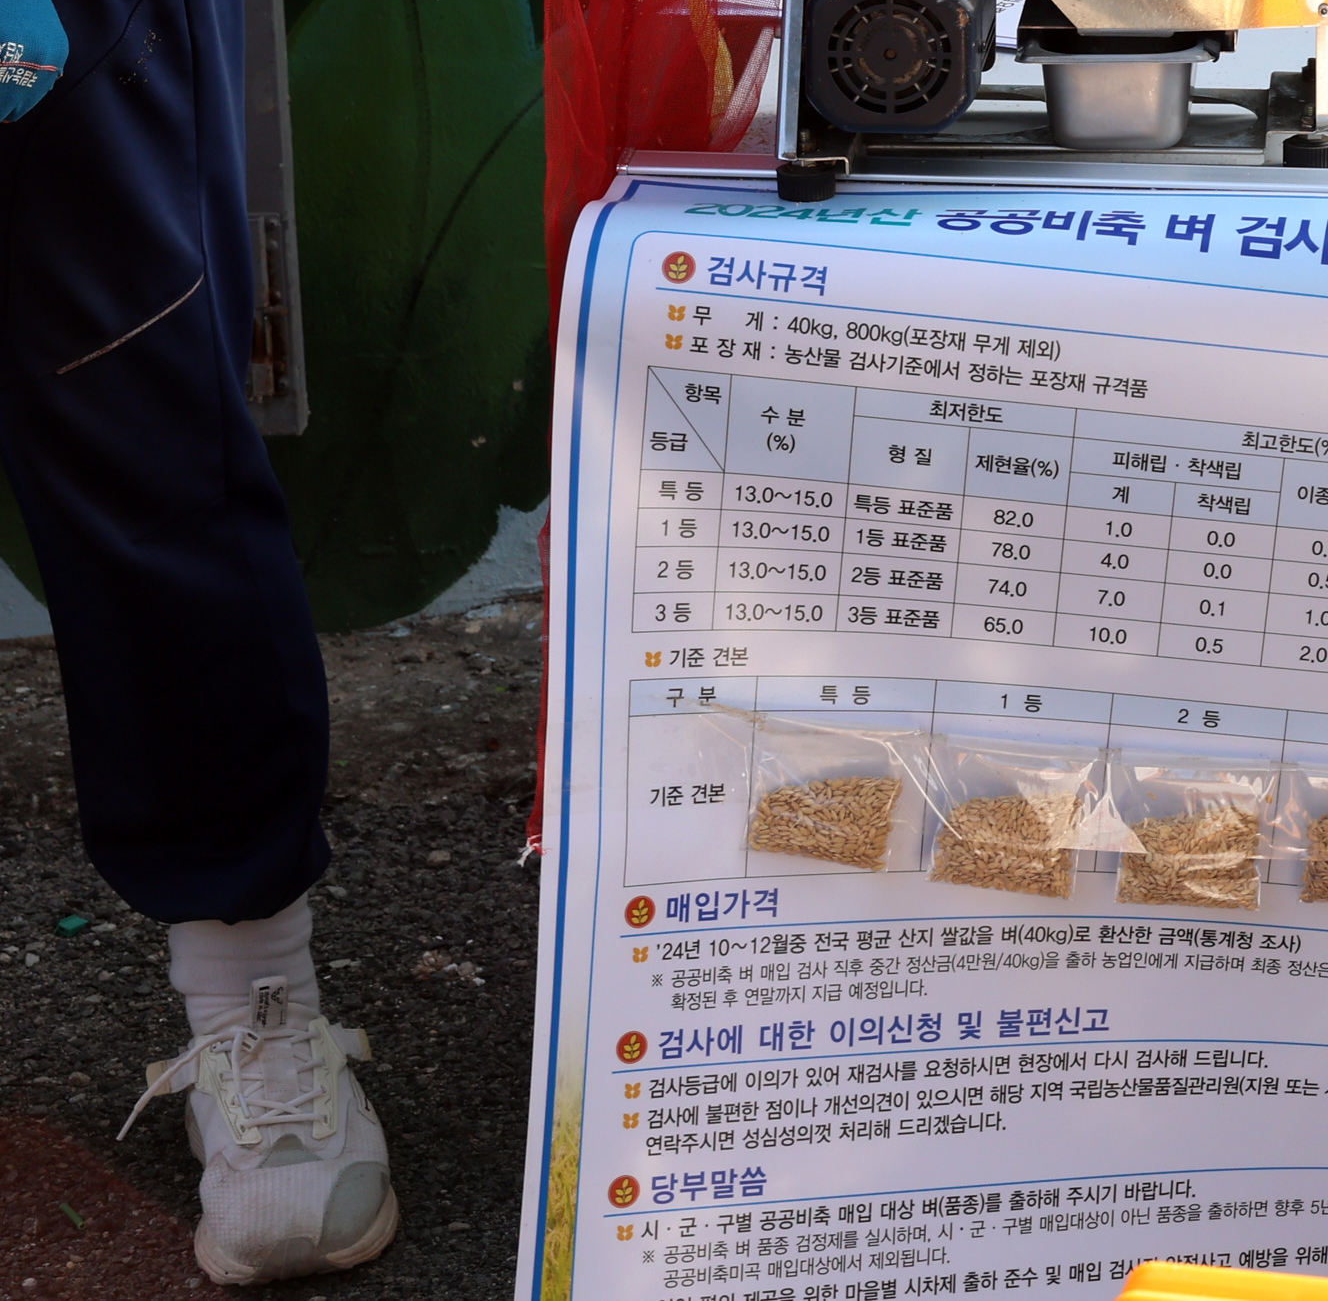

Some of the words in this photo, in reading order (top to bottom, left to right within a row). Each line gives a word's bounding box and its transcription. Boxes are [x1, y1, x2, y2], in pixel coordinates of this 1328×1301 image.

[684, 203, 925, 228] 2024년산
[935, 209, 1146, 246] 공공비축
[1165, 213, 1216, 254] 벼
[707, 256, 828, 297] 검사규격
[787, 316, 838, 340] 40kg,
[845, 321, 967, 352] 800kg(포장재
[972, 333, 1011, 357] 무게
[1016, 338, 1061, 362] 제외)
[784, 344, 842, 369] 농산물
[849, 351, 960, 381] 검사기준에서
[968, 363, 1024, 387] 정하는
[1029, 369, 1086, 393] 포장재
[1092, 375, 1149, 399] 규격품
[684, 382, 722, 405] 항목
[929, 400, 1004, 426] 최저한도
[649, 431, 689, 452] 등급
[975, 454, 1060, 480] 제현율(%)
[1112, 451, 1167, 474] 피해립
[1187, 457, 1242, 481] 착색립
[853, 494, 891, 515] 특등
[897, 499, 954, 521] 표준품
[993, 509, 1034, 528] 82.0
[1106, 520, 1133, 538] 1.0
[1206, 530, 1236, 548] 0.0
[1197, 493, 1251, 516] 착색립
[856, 528, 885, 548] 1등
[891, 531, 947, 553] 표준품
[992, 541, 1031, 561] 78.0
[1100, 552, 1130, 570] 4.0
[1203, 562, 1232, 580] 0.0
[851, 566, 882, 586] 2등
[887, 569, 944, 591] 표준품
[988, 578, 1027, 598] 74.0
[1098, 589, 1126, 607] 7.0
[1199, 599, 1225, 617] 0.1
[669, 647, 705, 669] 기준
[712, 646, 749, 667] 견본
[847, 606, 878, 626] 3등
[884, 608, 940, 629] 표준품
[983, 616, 1024, 635] 65.0
[1089, 626, 1127, 645] 10.0
[1195, 636, 1224, 654] 0.5
[1299, 645, 1328, 664] 2.0
[666, 887, 779, 923] 매입가격
[814, 931, 850, 953] 전국
[856, 929, 892, 951] 평균
[898, 927, 934, 949] 산지
[940, 925, 994, 947] 쌀값을
[1001, 924, 1092, 946] 벼(40kg)로
[1098, 924, 1153, 945] 환산한
[1158, 927, 1254, 950] 금액(통계청
[1259, 934, 1302, 954] 조사)
[671, 965, 733, 989] 공공비축
[760, 962, 791, 982] 매입
[797, 960, 828, 980] 검사
[833, 958, 864, 978] 직후
[869, 956, 901, 977] 중간
[1065, 950, 1097, 969] 출하
[1101, 951, 1179, 970] 농업인에게
[1183, 953, 1245, 973] 지급하며
[1250, 957, 1282, 975] 최종
[670, 990, 717, 1011] 확정된
[744, 984, 806, 1007] 연말까지
[811, 983, 843, 1002] 지급
[848, 978, 928, 1000] 예정입니다.
[658, 1024, 743, 1060] 검사에
[759, 1020, 816, 1052] 대한
[830, 1012, 942, 1048] 이의신청
[957, 1010, 982, 1041] 및
[996, 1006, 1110, 1039] 불편신고
[648, 1072, 738, 1099] 검사등급에
[745, 1068, 799, 1091] 이의가
[805, 1065, 840, 1088] 있어
[847, 1060, 918, 1084] 재검사를
[923, 1054, 1011, 1079] 요청하시면
[1018, 1051, 1087, 1074] 현장에서
[1094, 1049, 1129, 1070] 다시
[1136, 1049, 1188, 1069] 검사해
[1193, 1049, 1268, 1069] 드립니다.
[647, 1105, 699, 1130] 검사에
[705, 1101, 760, 1125] 불편한
[765, 1096, 818, 1121] 점이나
[823, 1090, 910, 1116] 개선의견이
[916, 1085, 984, 1110] 있으시면
[990, 1083, 1025, 1105] 해당
[1030, 1081, 1064, 1102] 지역
[1284, 1078, 1320, 1097] 또는
[645, 1129, 735, 1157] 연락주시면
[742, 1122, 832, 1150] 성심성의껏
[838, 1118, 891, 1142] 처리해
[897, 1110, 1006, 1136] 드리겠습니다.
[651, 1166, 768, 1205] 당부말씀
[759, 1207, 831, 1232] 공공비축
[838, 1202, 873, 1224] 매입
[880, 1199, 916, 1221] 대상
[922, 1192, 1003, 1218] 벼(품종)를
[1008, 1187, 1060, 1211] 출하해
[1066, 1183, 1117, 1207] 주시기
[1124, 1178, 1196, 1202] 바랍니다.
[663, 1262, 761, 1289] 공공비축미곡
[767, 1253, 862, 1279] 매입대상에서
[868, 1246, 951, 1270] 제외됩니다.
